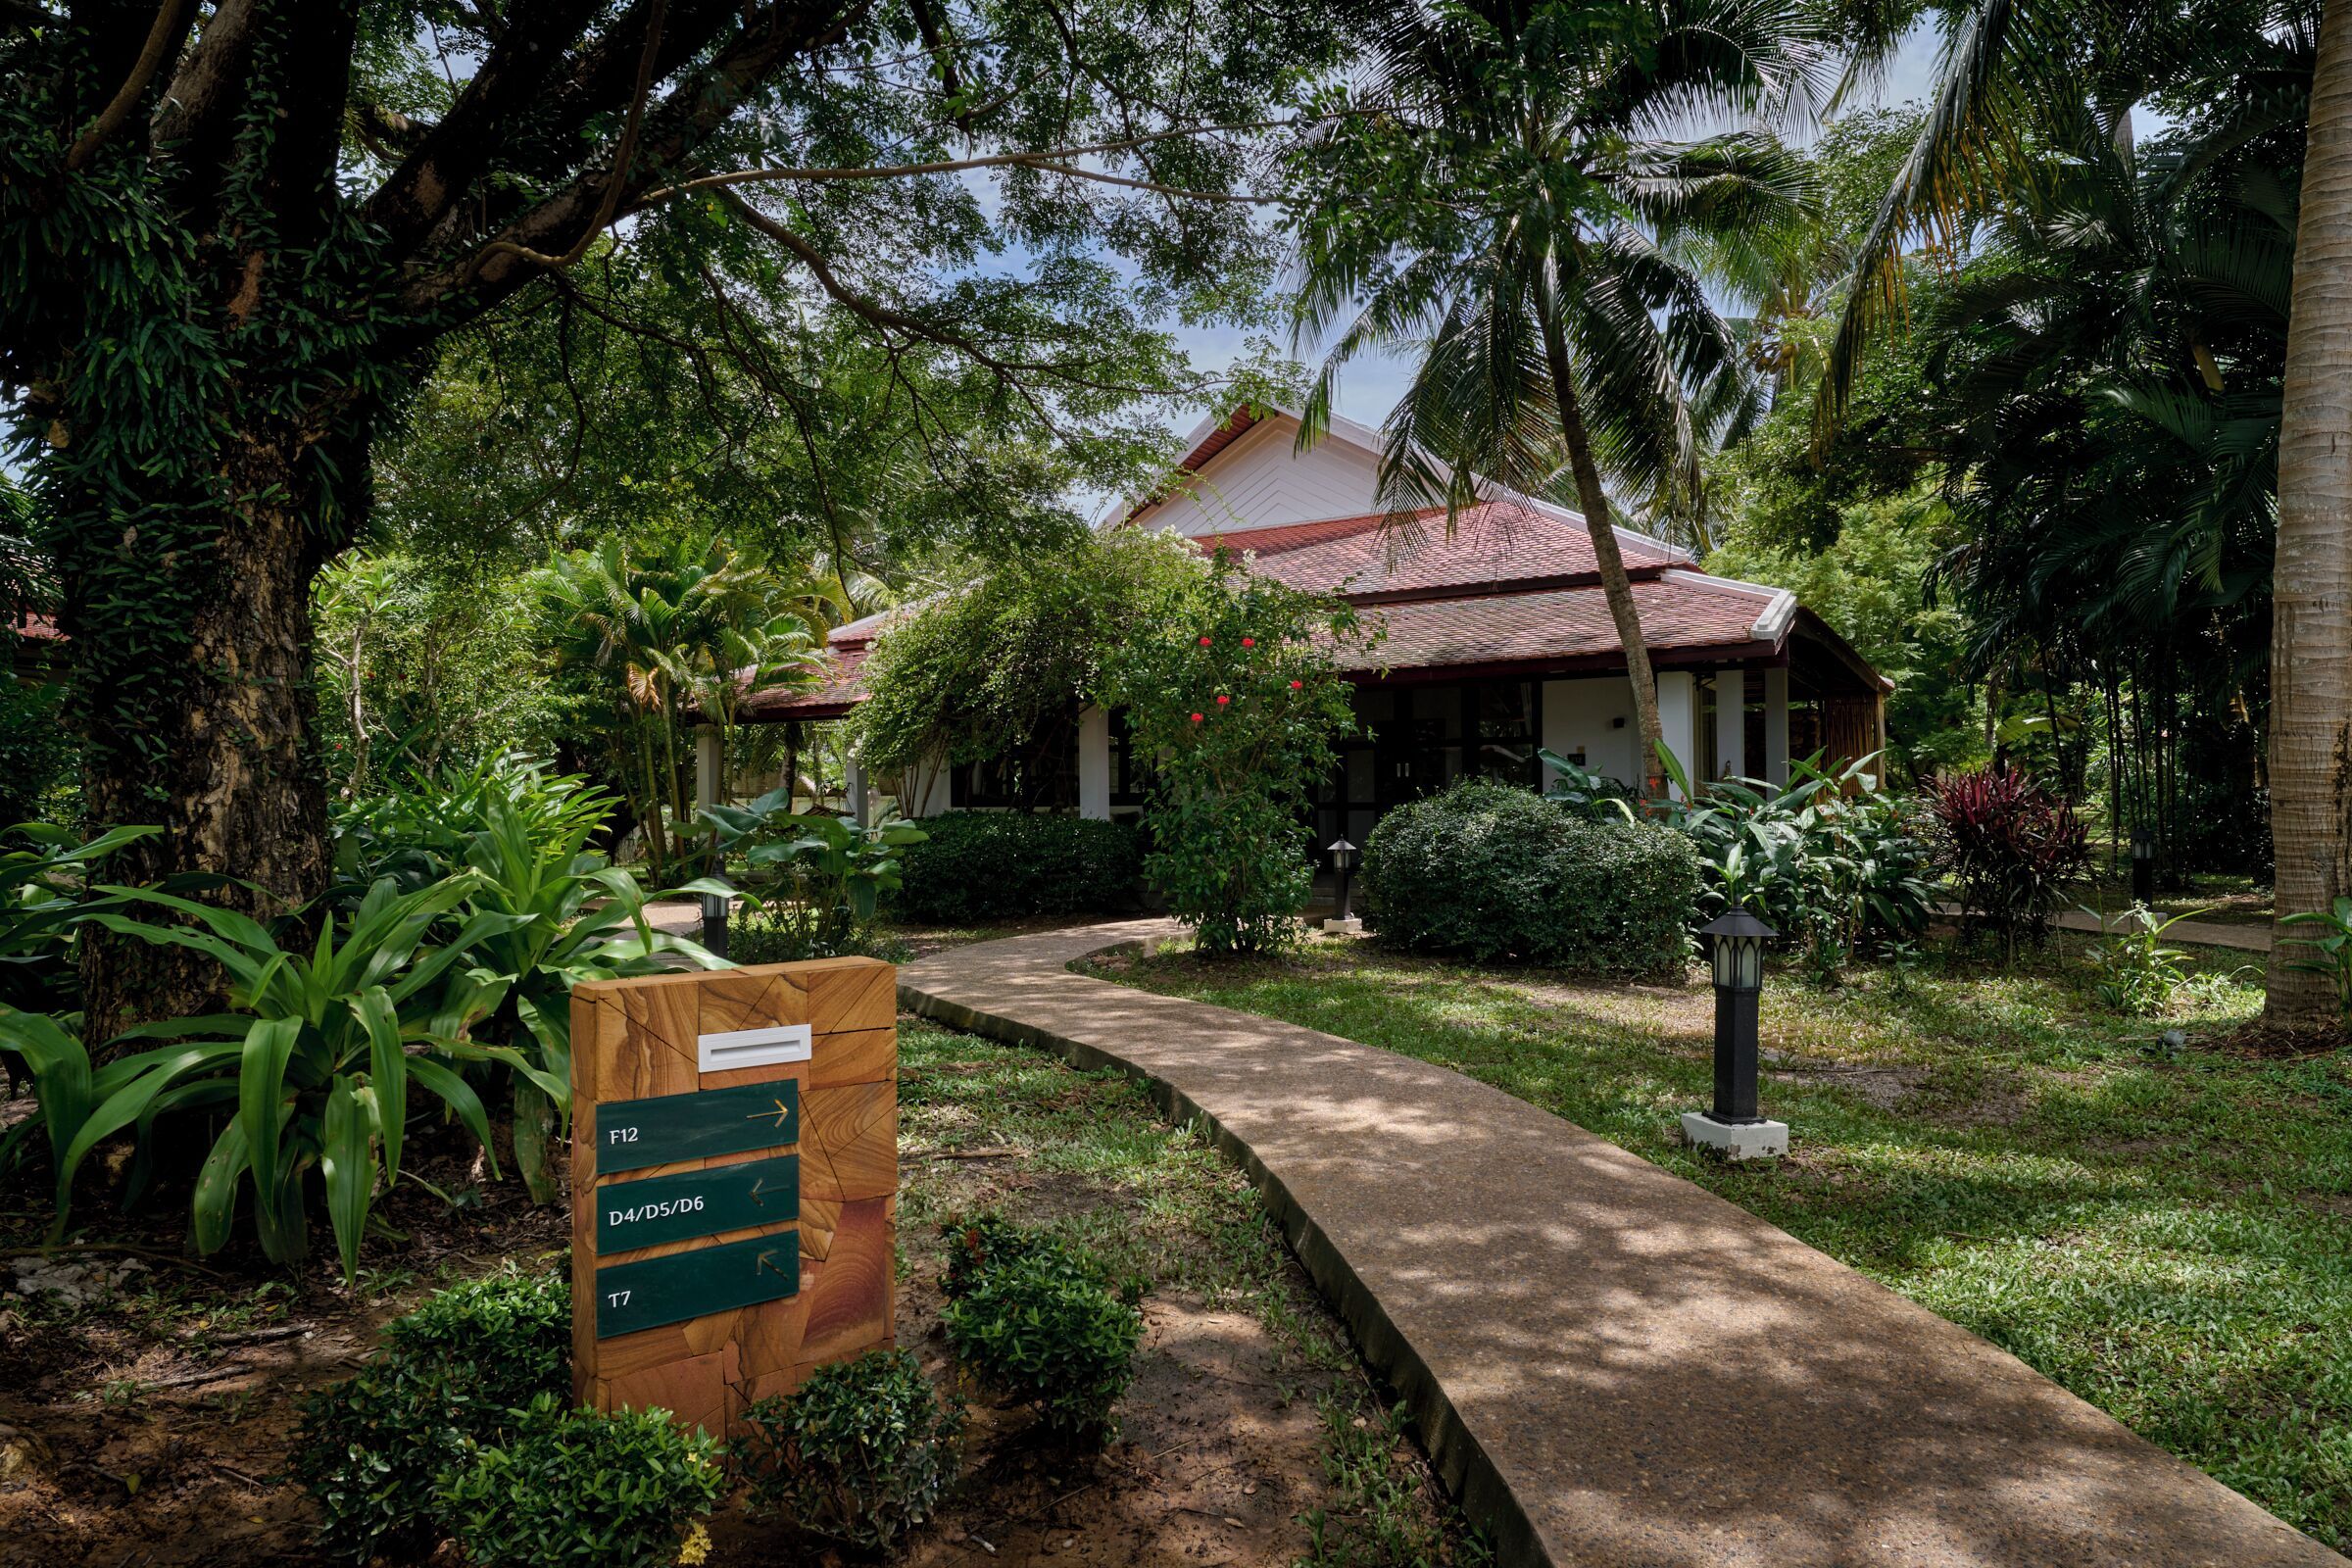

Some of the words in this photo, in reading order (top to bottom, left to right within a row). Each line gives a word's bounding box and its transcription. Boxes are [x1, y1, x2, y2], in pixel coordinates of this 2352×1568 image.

[610, 1127, 639, 1145] F12
[609, 1196, 705, 1226] D4/D5/D6
[609, 1290, 631, 1308] T7
